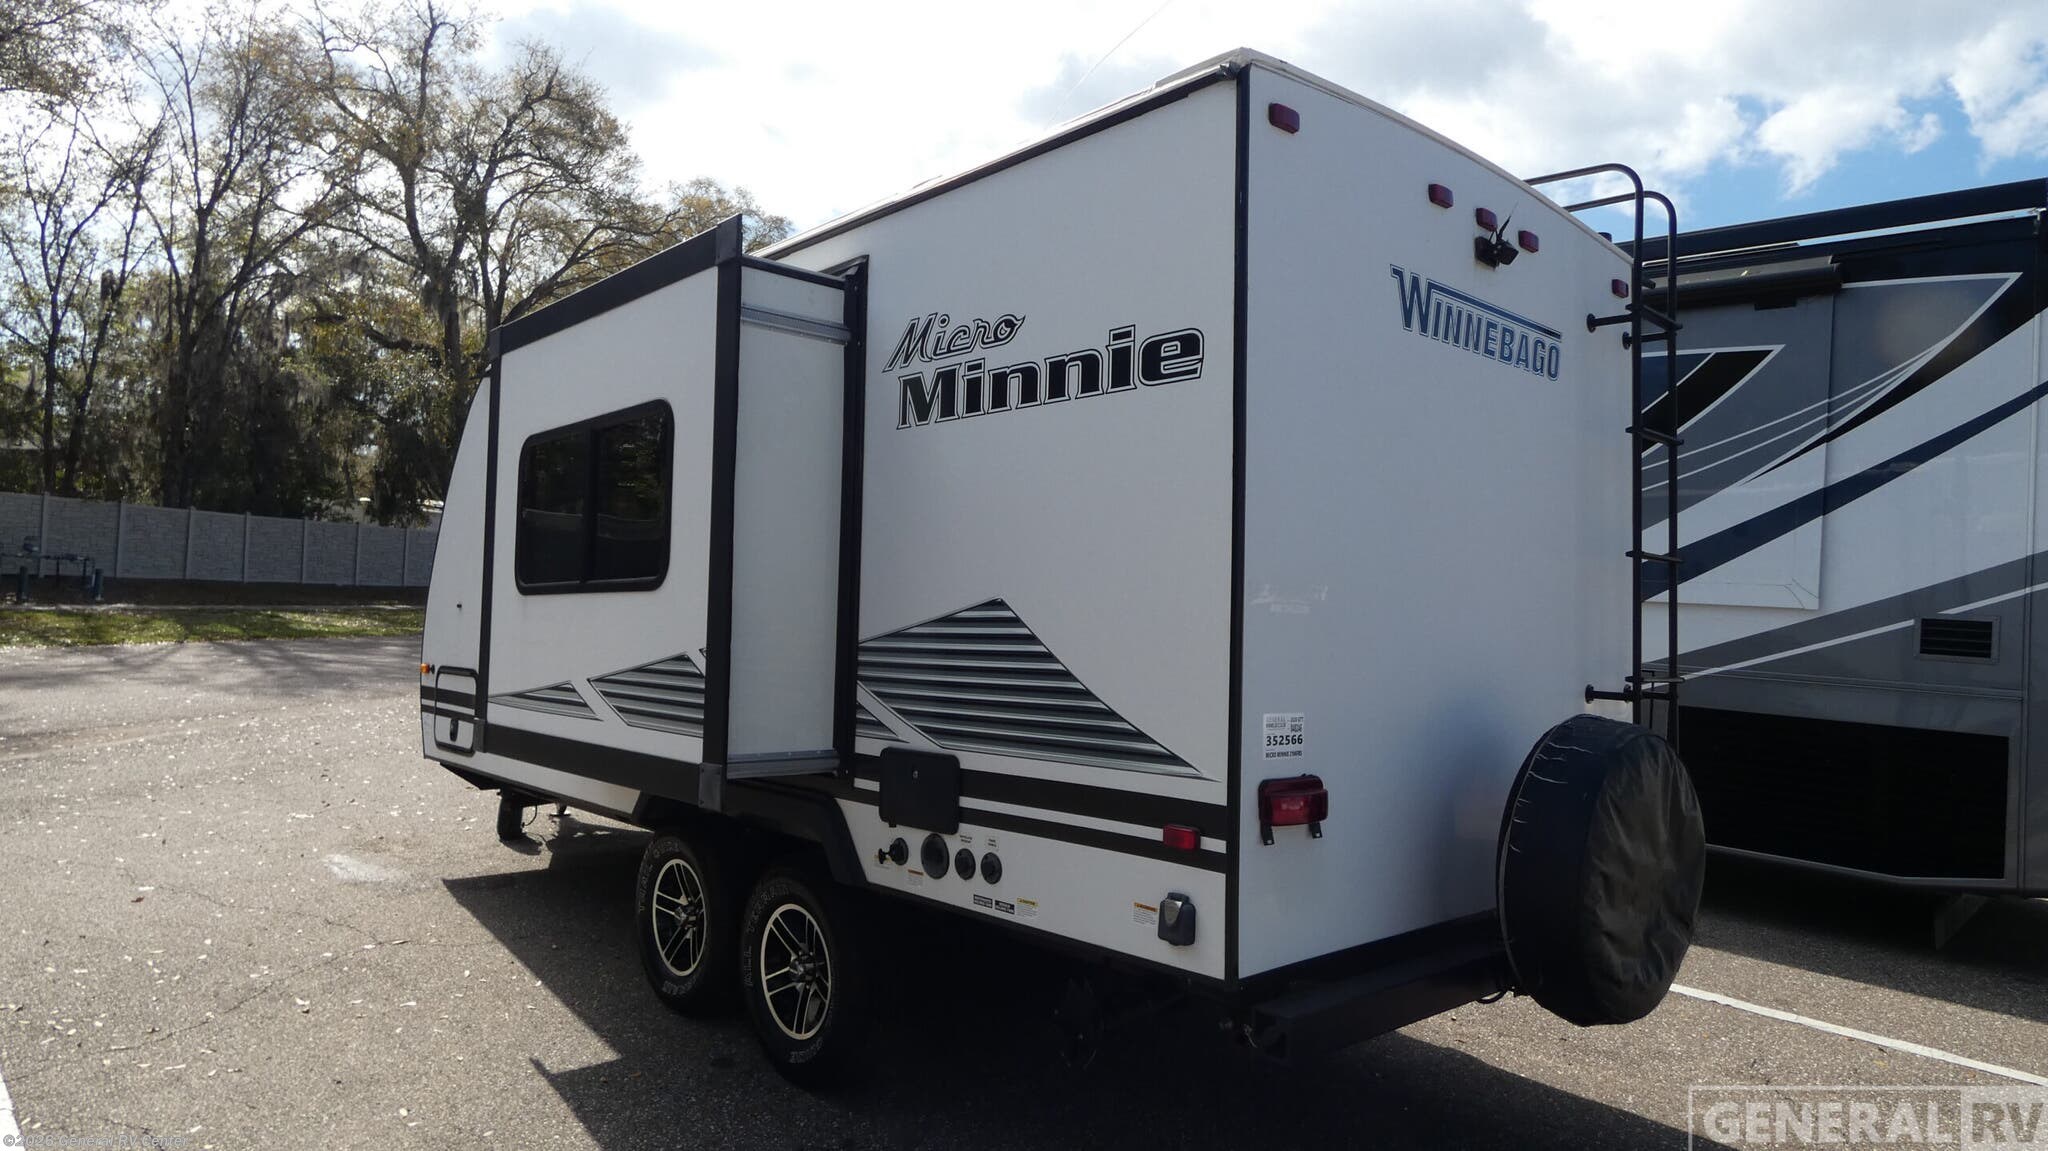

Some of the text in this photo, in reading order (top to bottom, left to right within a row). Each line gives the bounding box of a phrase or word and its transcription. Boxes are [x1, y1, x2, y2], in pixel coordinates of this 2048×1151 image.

[882, 312, 1026, 373] Micro
[1390, 263, 1561, 381] WINNEBAGO
[896, 324, 1206, 430] Minnie
[1266, 734, 1303, 746] 352566
